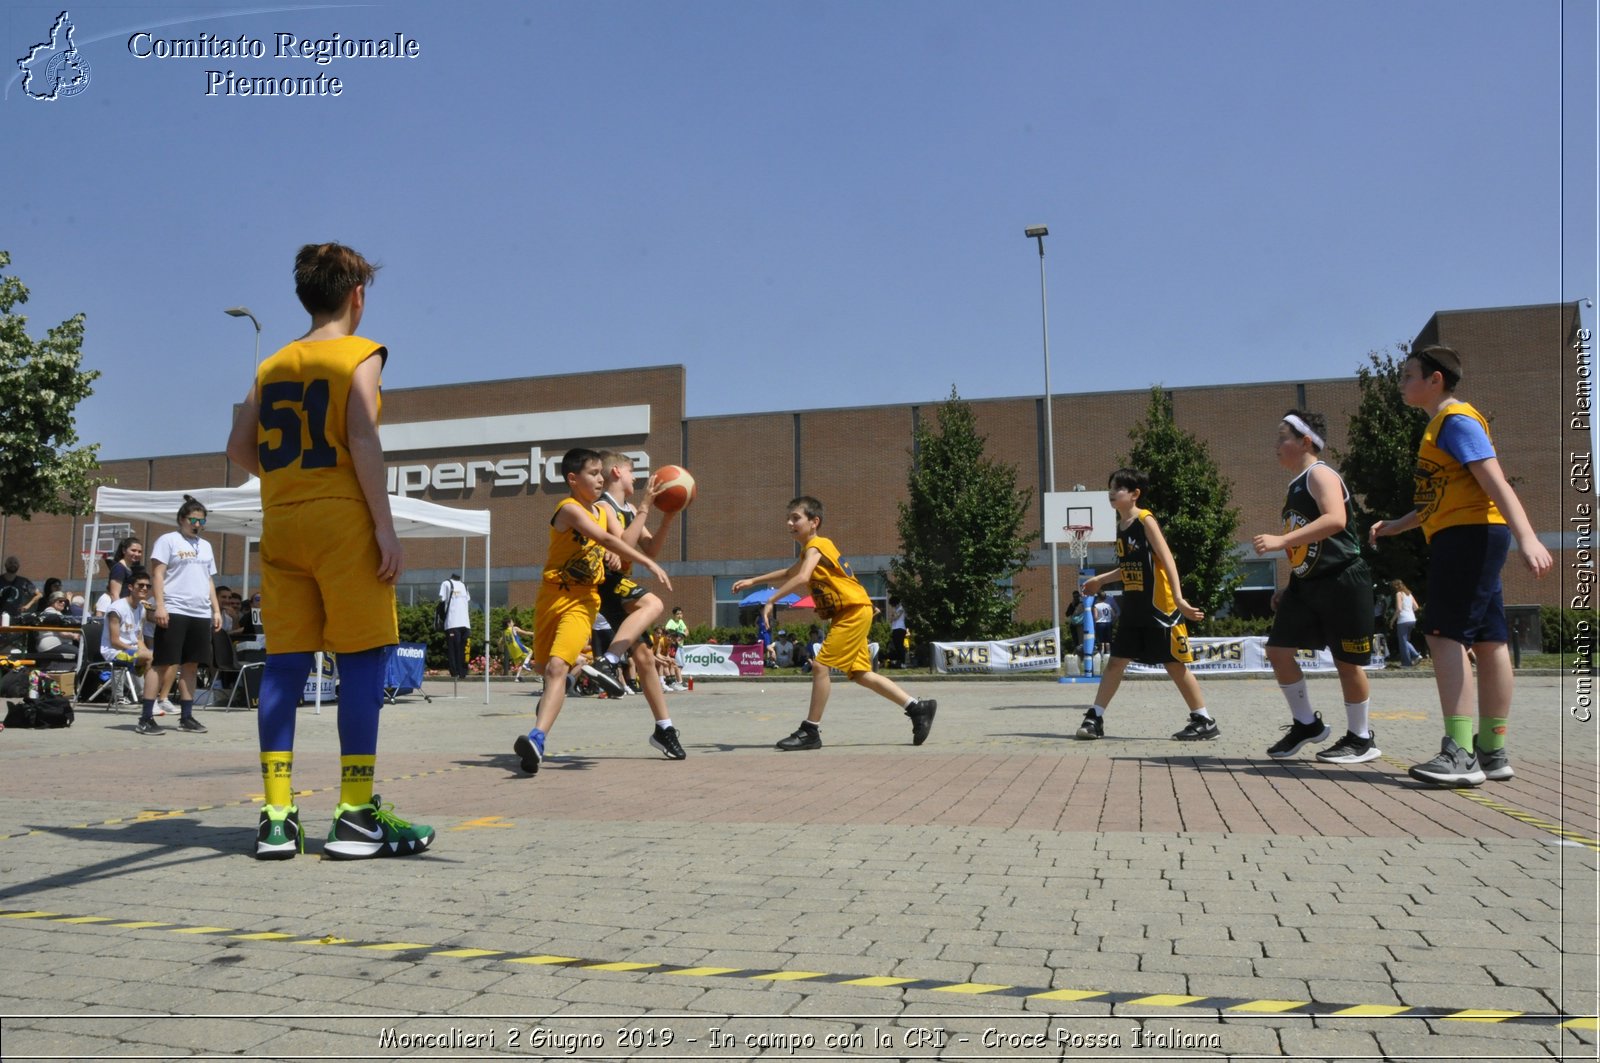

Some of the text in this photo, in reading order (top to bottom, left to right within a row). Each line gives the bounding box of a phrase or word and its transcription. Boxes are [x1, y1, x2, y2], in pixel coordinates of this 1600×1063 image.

[258, 379, 337, 473] 51
[397, 646, 424, 659] molten
[943, 646, 990, 666] PMS
[1009, 639, 1056, 661] PMS
[1191, 643, 1242, 661] PMS
[684, 652, 725, 667] ttaglio
[1009, 658, 1058, 670] BASKETBALL
[1190, 663, 1244, 671] BASKETBALL
[341, 765, 375, 777] PMS
